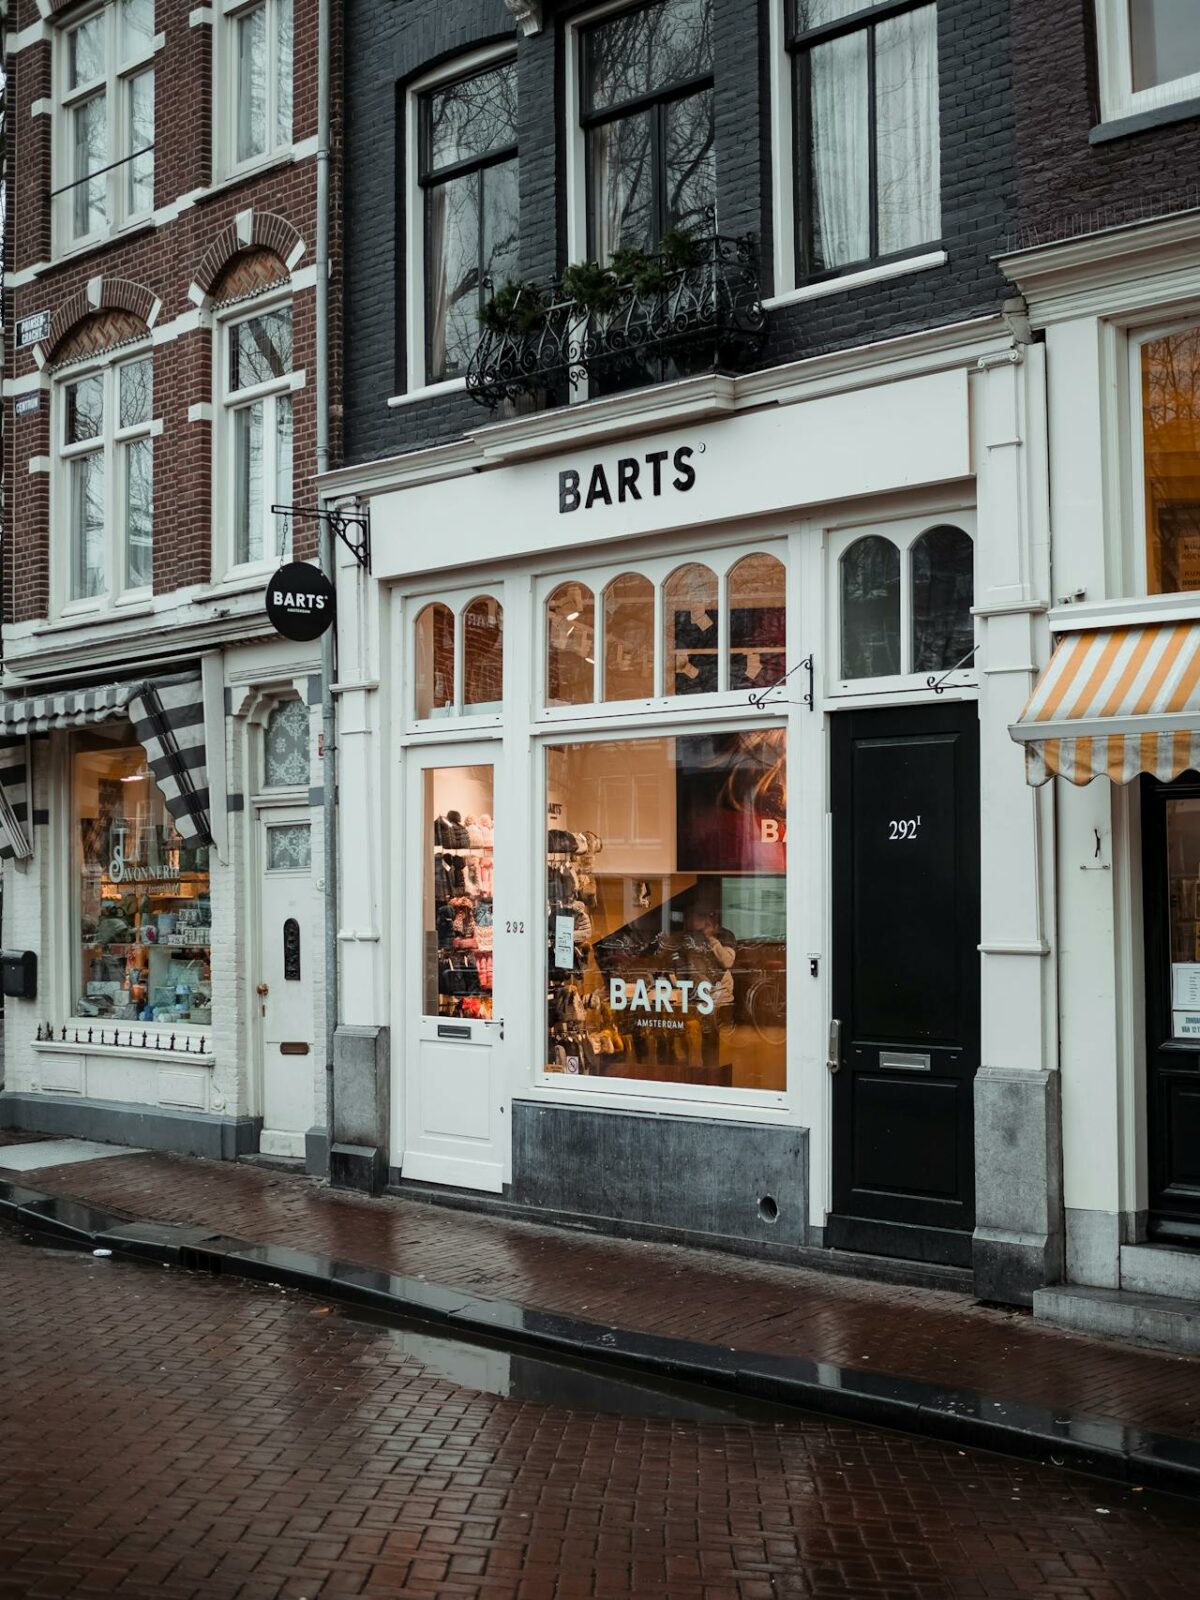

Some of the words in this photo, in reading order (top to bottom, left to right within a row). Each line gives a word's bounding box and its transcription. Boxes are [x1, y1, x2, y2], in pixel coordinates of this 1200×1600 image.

[559, 446, 696, 514] BARTS
[273, 591, 325, 609] BARTS
[761, 818, 786, 843] B
[506, 920, 524, 934] 292
[609, 977, 715, 1015] BARTS
[637, 1018, 685, 1029] AMSTERDAM
